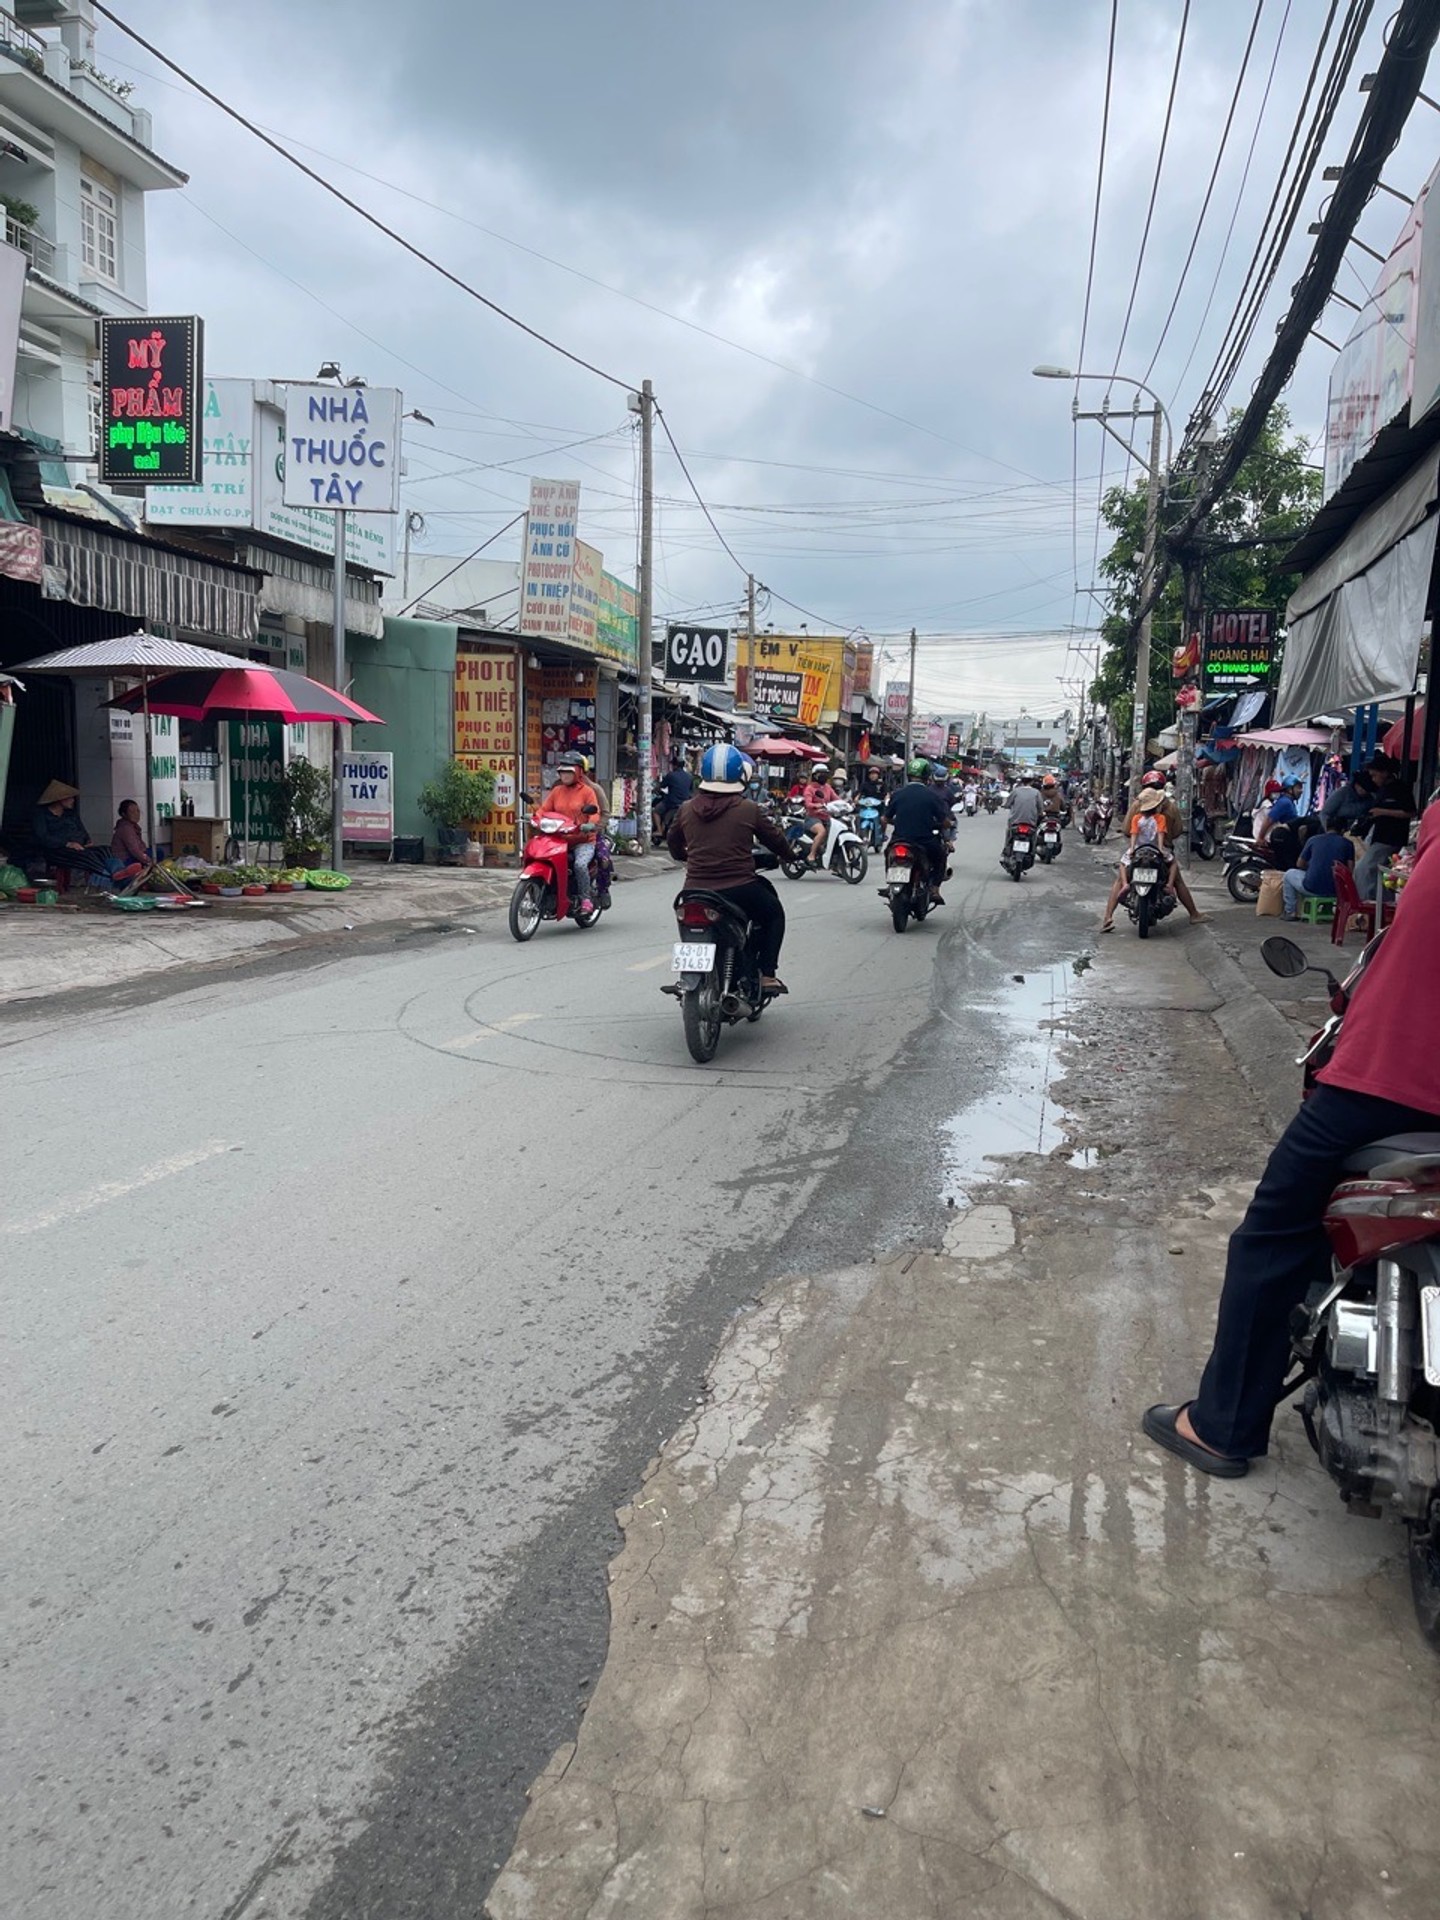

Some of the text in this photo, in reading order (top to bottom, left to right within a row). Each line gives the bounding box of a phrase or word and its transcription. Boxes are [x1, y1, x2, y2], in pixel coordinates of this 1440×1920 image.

[128, 331, 166, 368] MỸ
[112, 371, 182, 417] PHẨM
[308, 390, 368, 424] NHÀ
[213, 432, 250, 466] TÂY
[292, 428, 386, 467] THUỐC
[310, 473, 362, 505] TÂY
[530, 522, 555, 539] PHỤC
[527, 581, 570, 602] IN THIỆP
[1212, 613, 1271, 643] HOTEL
[671, 633, 723, 674] GẠO
[456, 661, 515, 681] PHOTO
[455, 687, 515, 717] IN THIỆP
[782, 690, 799, 705] NAM
[240, 722, 270, 747] NHÀ
[457, 721, 491, 735] PHỤC
[462, 735, 511, 750] ẢNH CŨ
[232, 753, 282, 783] THUỐC
[342, 761, 388, 779] THUỐC
[350, 782, 378, 799] TÂY
